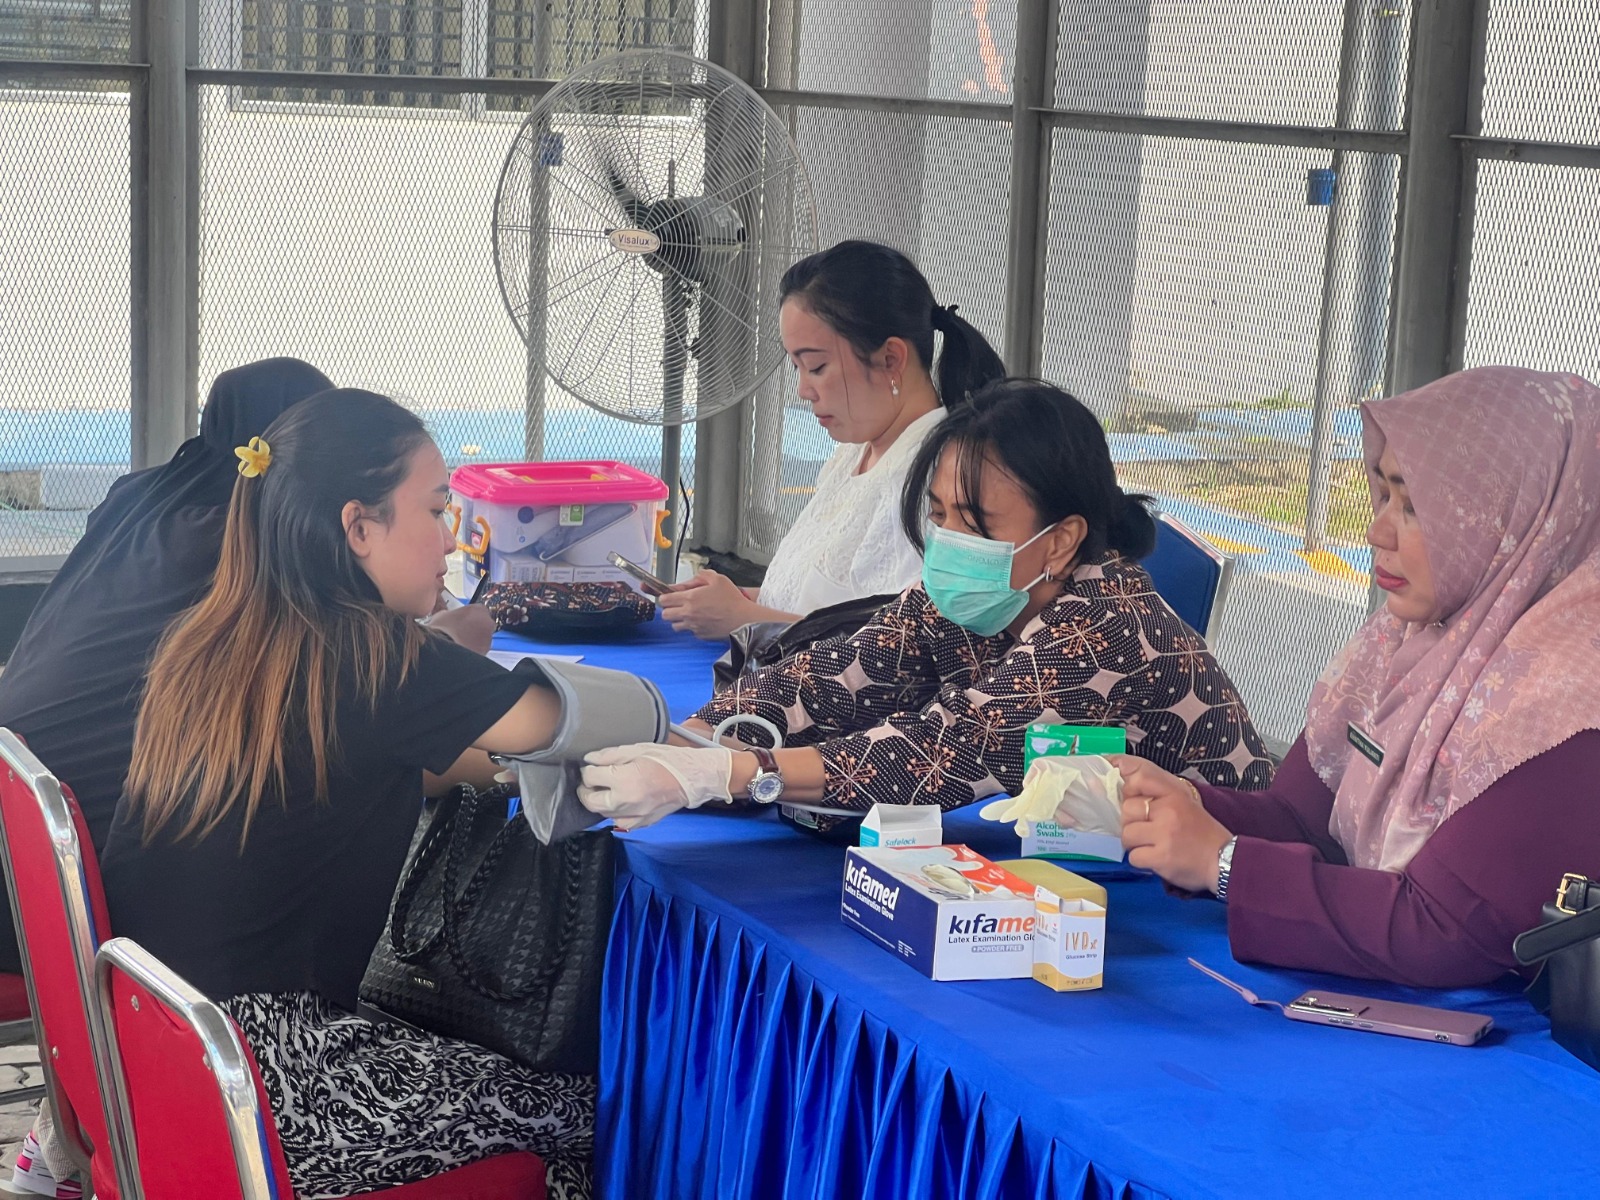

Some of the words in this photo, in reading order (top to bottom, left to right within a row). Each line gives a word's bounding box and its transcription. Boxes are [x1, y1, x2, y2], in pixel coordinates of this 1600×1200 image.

[618, 233, 650, 246] Visalux
[1035, 822, 1066, 830] Alcoh
[1036, 829, 1065, 838] Swabs
[949, 913, 1035, 935] kifame
[948, 935, 970, 944] Latex
[972, 932, 1022, 943] Examination
[1023, 933, 1035, 941] Glo
[1086, 952, 1098, 960] Strip
